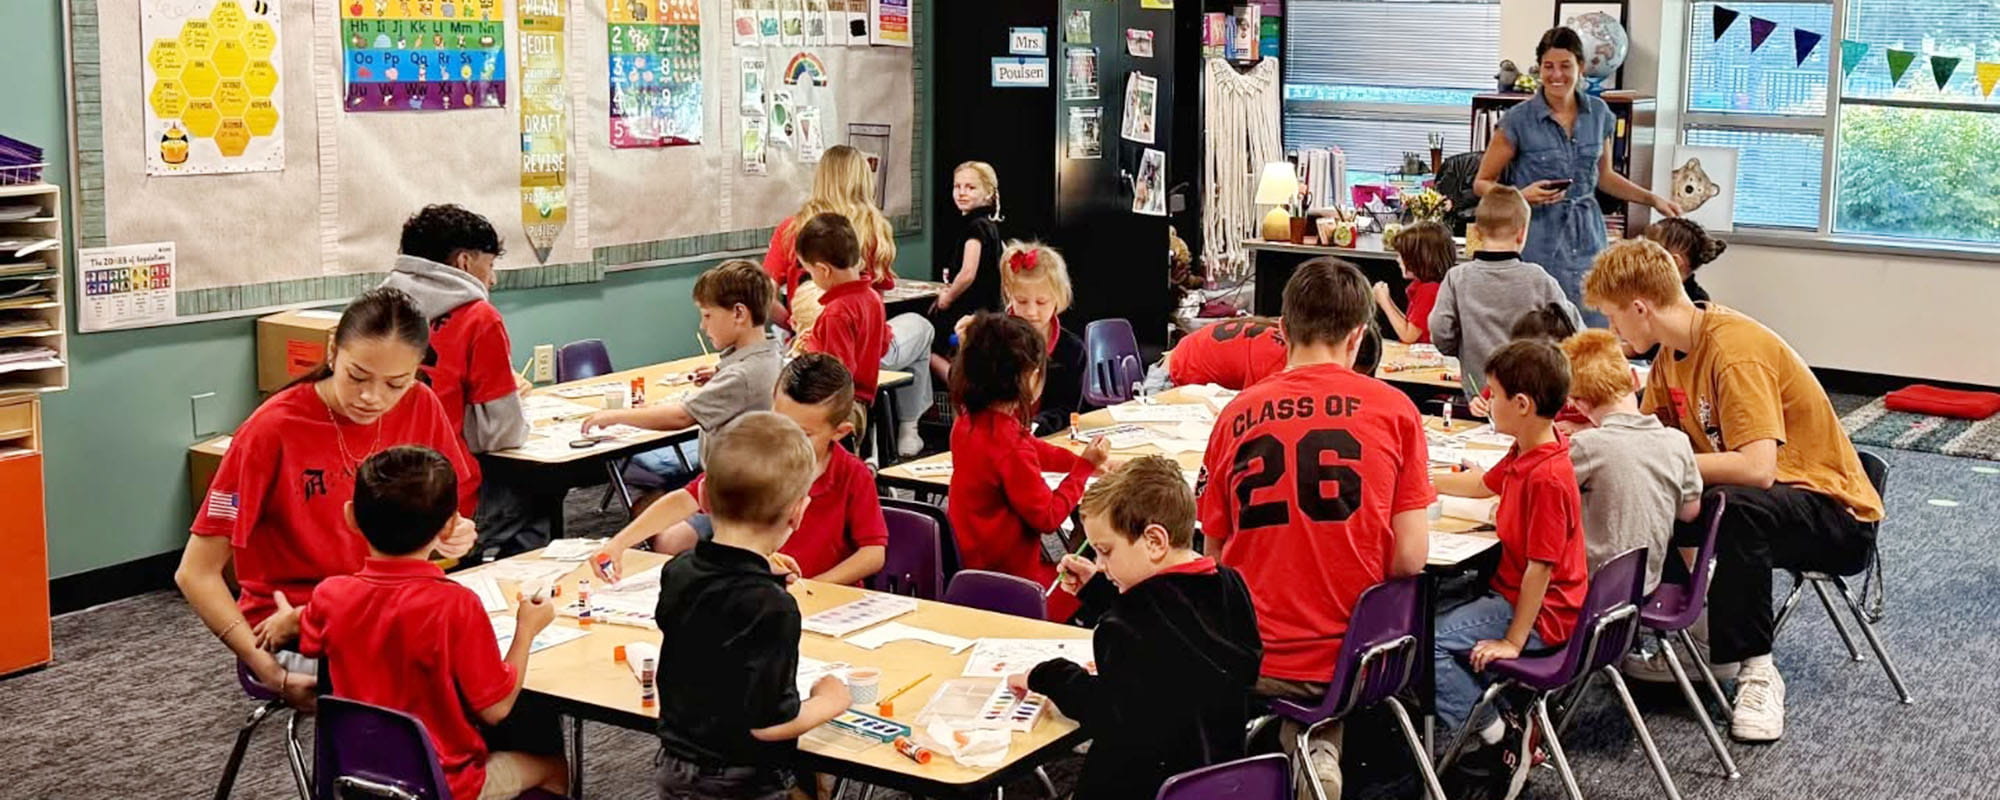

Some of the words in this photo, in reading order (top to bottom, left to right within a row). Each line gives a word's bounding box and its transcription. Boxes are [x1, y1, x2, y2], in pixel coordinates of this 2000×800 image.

[526, 0, 558, 16] PLAN
[659, 0, 668, 13] 6
[351, 20, 368, 32] Hh
[392, 20, 402, 36] Jj
[410, 21, 426, 33] Kk
[433, 21, 443, 33] Ll
[450, 21, 472, 33] Mm
[612, 26, 622, 44] 2
[660, 27, 669, 44] 7
[527, 35, 555, 54] EDIT
[1015, 35, 1041, 49] Mrs.
[354, 52, 373, 65] Oo
[384, 52, 400, 67] Pp
[410, 52, 428, 67] Qq
[438, 52, 450, 64] Rr
[460, 51, 472, 64] Ss
[613, 57, 622, 75] 3
[660, 58, 670, 75] 8
[999, 66, 1044, 81] Poulsen
[350, 83, 368, 96] Uu
[405, 83, 428, 96] Ww
[661, 88, 672, 105] 9
[524, 113, 561, 133] DRAFT
[614, 120, 624, 138] 5
[659, 118, 676, 136] 10
[523, 153, 565, 173] REVISE
[1232, 396, 1314, 438] CLASS
[1325, 395, 1361, 417] OF
[1232, 428, 1363, 529] 26
